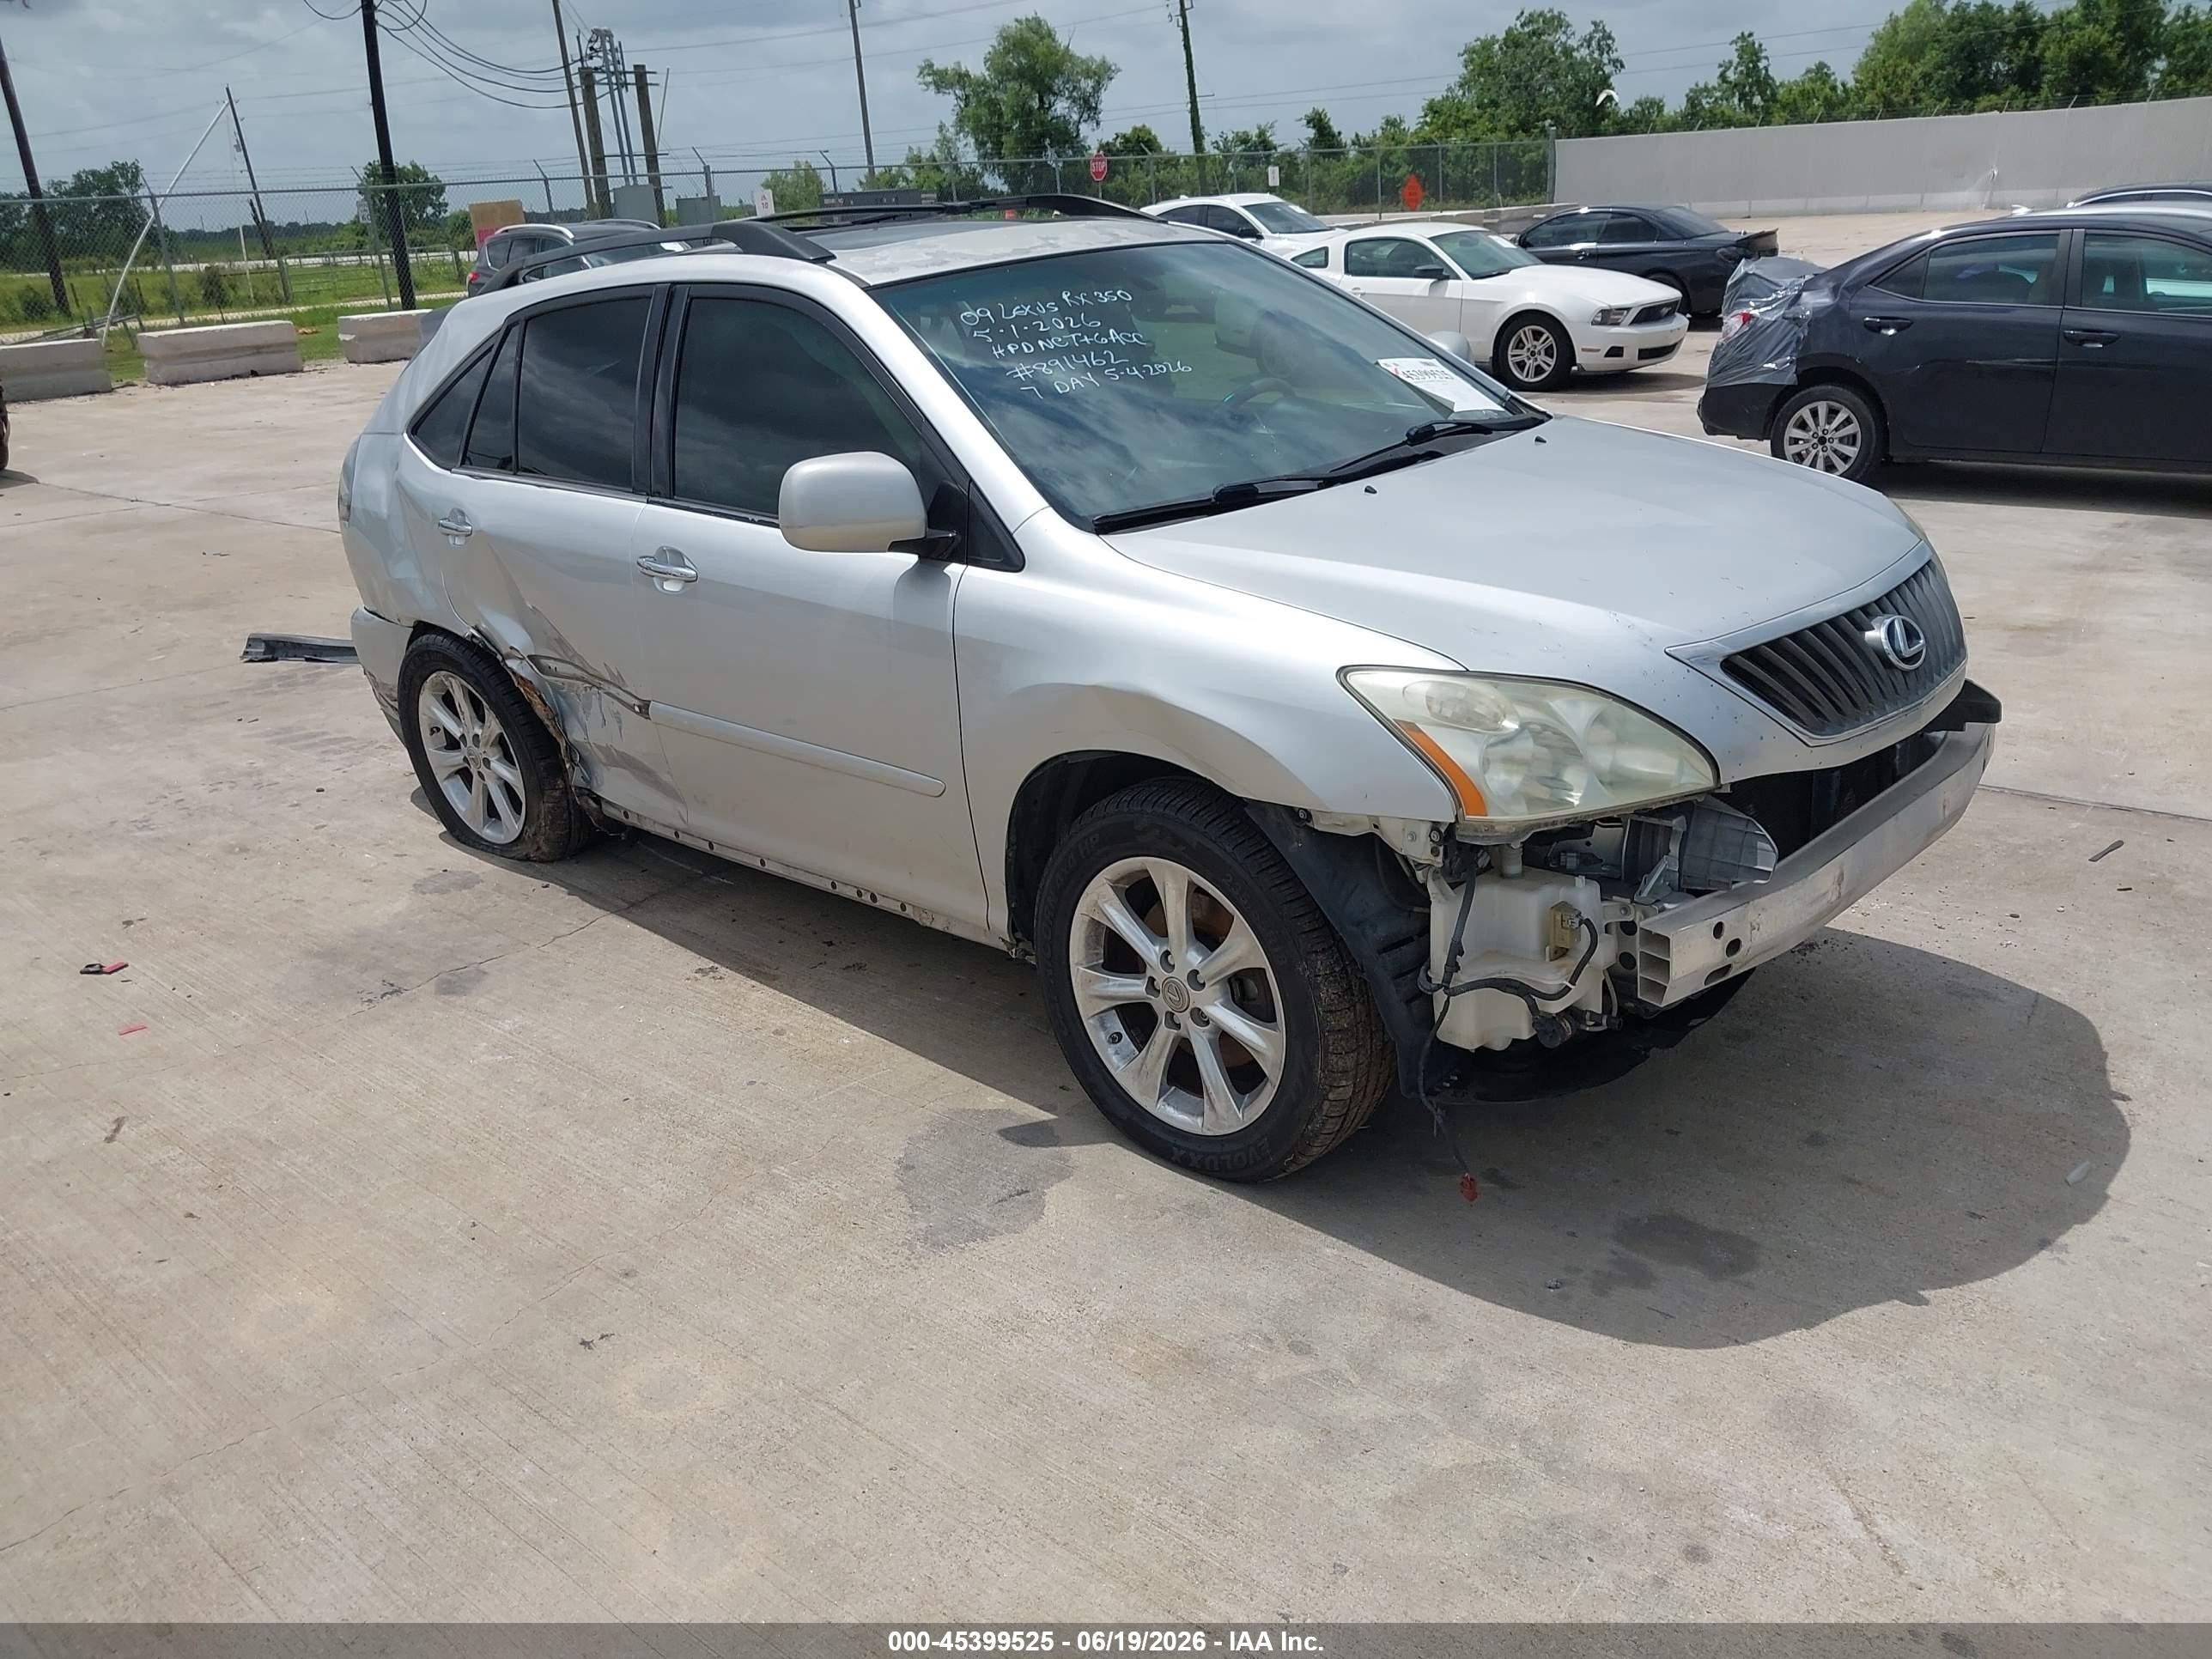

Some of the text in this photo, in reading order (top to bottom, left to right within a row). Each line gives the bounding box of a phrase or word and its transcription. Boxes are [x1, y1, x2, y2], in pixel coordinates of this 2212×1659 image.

[1091, 161, 1106, 172] STOP
[960, 307, 995, 325] 09
[1093, 289, 1133, 303] 350
[1006, 349, 1129, 381] #891462
[1054, 372, 1100, 394] DAY
